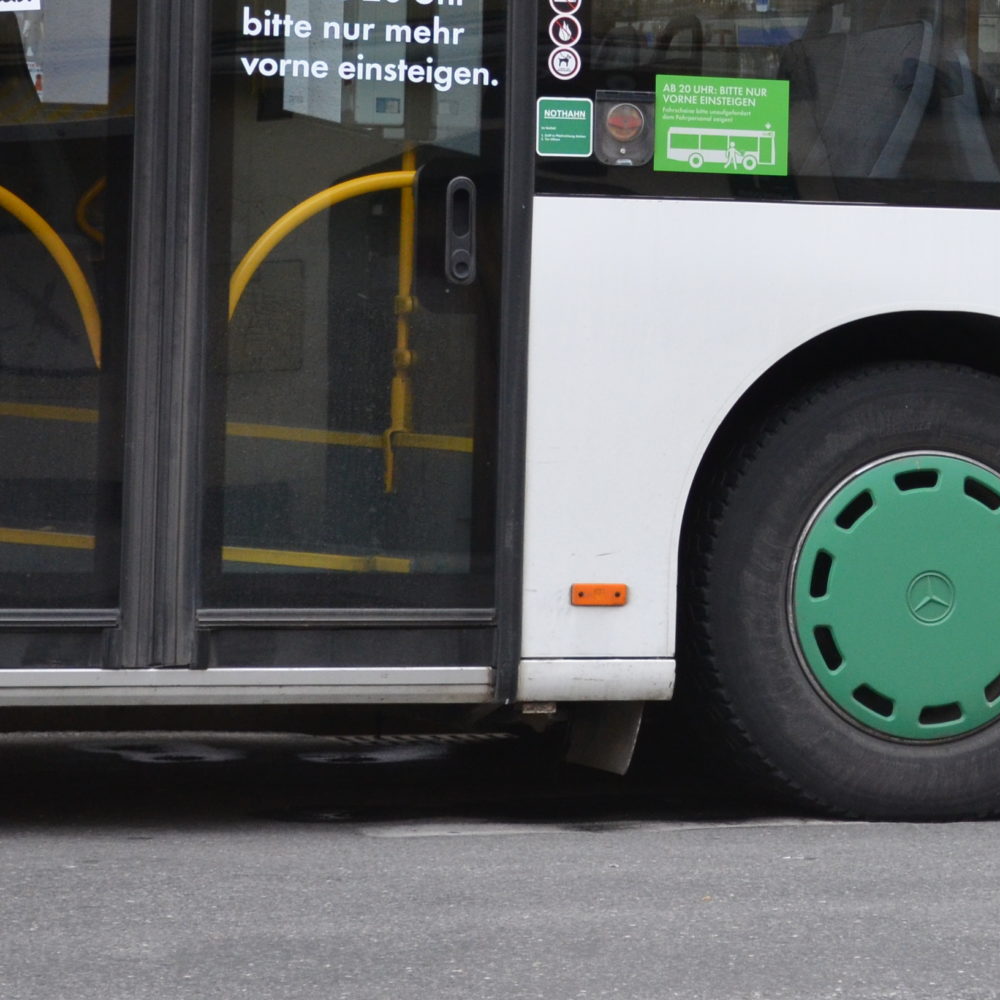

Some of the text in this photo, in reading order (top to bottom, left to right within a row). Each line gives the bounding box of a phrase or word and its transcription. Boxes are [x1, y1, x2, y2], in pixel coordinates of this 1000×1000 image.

[242, 6, 465, 45] bitte nur mehr
[240, 53, 499, 92] vorne einsteigen.
[662, 83, 768, 98] AB 20 UHR: BITTE NUR
[662, 94, 757, 107] VORNE EINSTEIGEN
[543, 109, 587, 119] NOTHAHN
